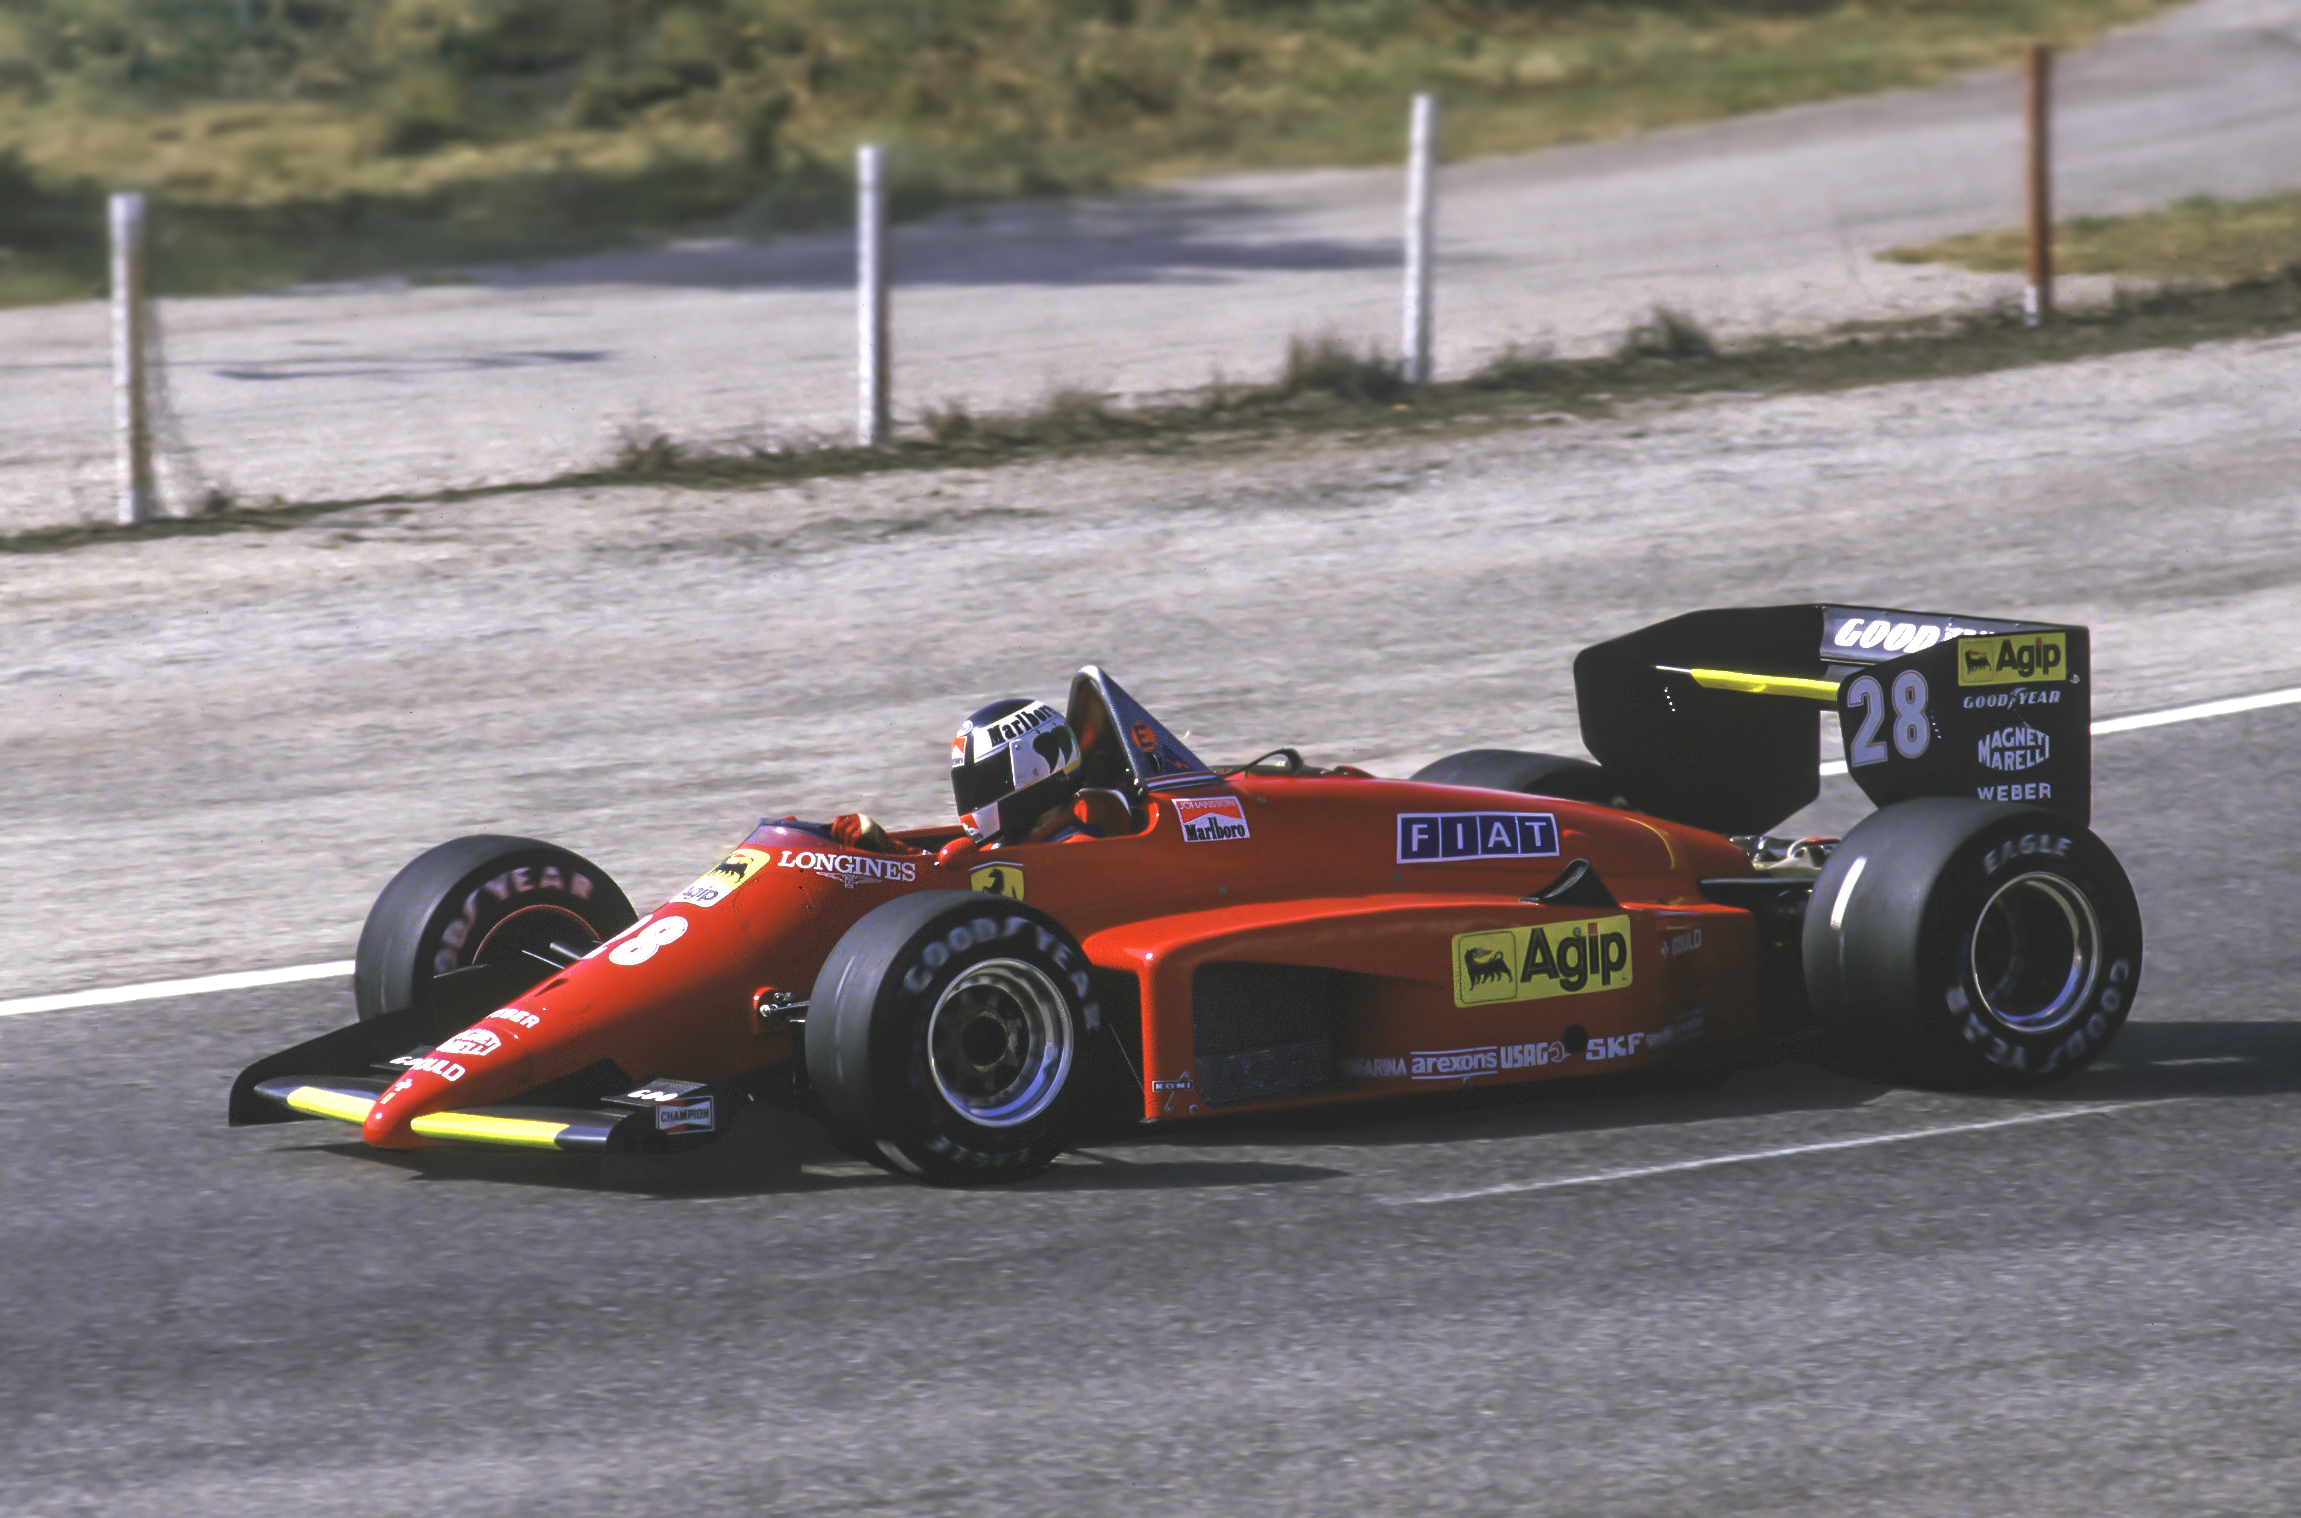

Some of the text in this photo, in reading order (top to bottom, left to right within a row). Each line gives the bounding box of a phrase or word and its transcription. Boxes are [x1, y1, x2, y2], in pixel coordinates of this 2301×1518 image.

[1995, 636, 2062, 679] Agip
[1963, 687, 2062, 710] GOODYEAR
[1847, 669, 1931, 768] 28
[1978, 726, 2050, 758] MAGNETI
[1978, 741, 2050, 771] MARELLI
[1179, 799, 1236, 811] JOHANSSON
[1977, 782, 2052, 801] WEBER
[1184, 817, 1246, 842] Marlboro
[1411, 821, 1547, 852] FIAT
[777, 850, 917, 882] LONGINES
[1983, 833, 2073, 875] EAGLE
[1519, 927, 1629, 992] Agip
[1500, 1042, 1549, 1069] USAG
[1585, 1031, 1646, 1061] SKF
[1411, 1052, 1498, 1075] arexons
[1155, 1082, 1191, 1090] KONI
[660, 1107, 711, 1124] CHAMPION
